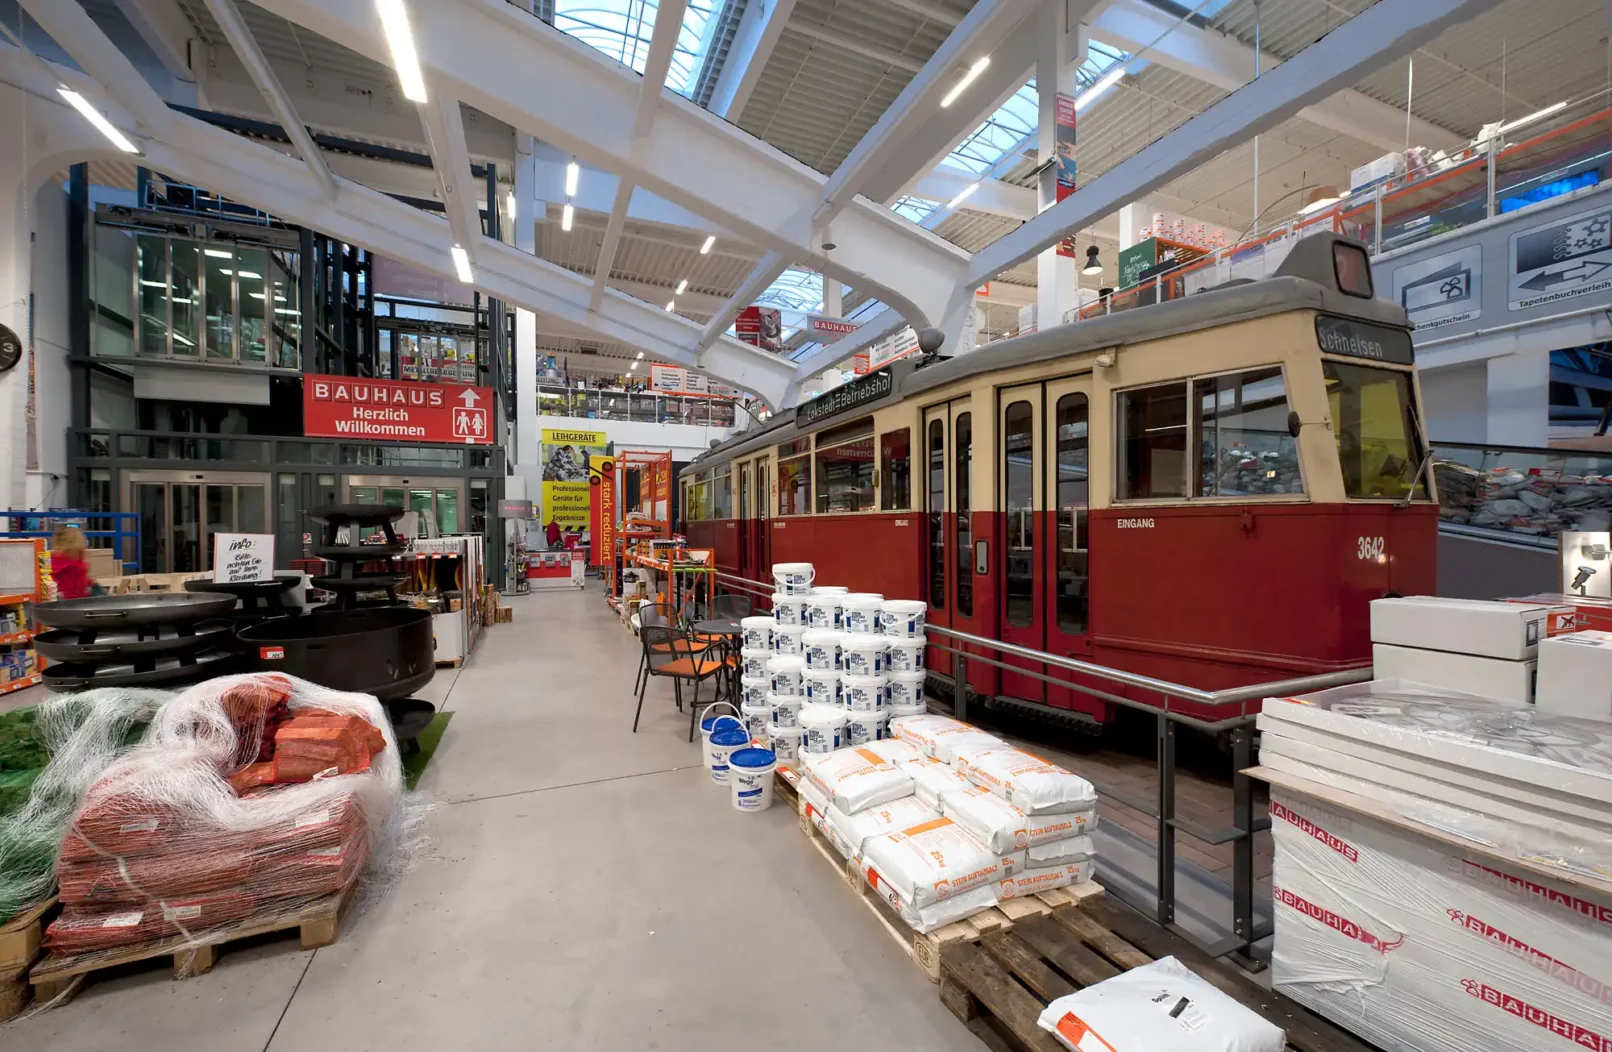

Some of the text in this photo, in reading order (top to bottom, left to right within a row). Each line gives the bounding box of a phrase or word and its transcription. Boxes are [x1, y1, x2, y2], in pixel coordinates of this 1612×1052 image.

[1518, 281, 1612, 309] Tapetenbuchverleih
[1319, 327, 1383, 358] Schnelsen
[315, 383, 442, 405] BAUHAUS
[353, 406, 409, 421] Herzlich
[335, 420, 426, 437] Willkommen
[552, 432, 596, 442] LEIHGERÄTE
[574, 494, 583, 502] für
[552, 514, 585, 522] Ergebnisse
[602, 481, 612, 561] stark reduziert
[1117, 518, 1155, 528] EINGANG
[1358, 536, 1385, 561] 3642
[1270, 801, 1358, 862] AUHAUS
[951, 875, 968, 888] STEIN
[967, 864, 999, 882] AUFTAUSALZ
[1017, 876, 1032, 887] STEIN
[1032, 871, 1064, 884] AUFTAUSALZ
